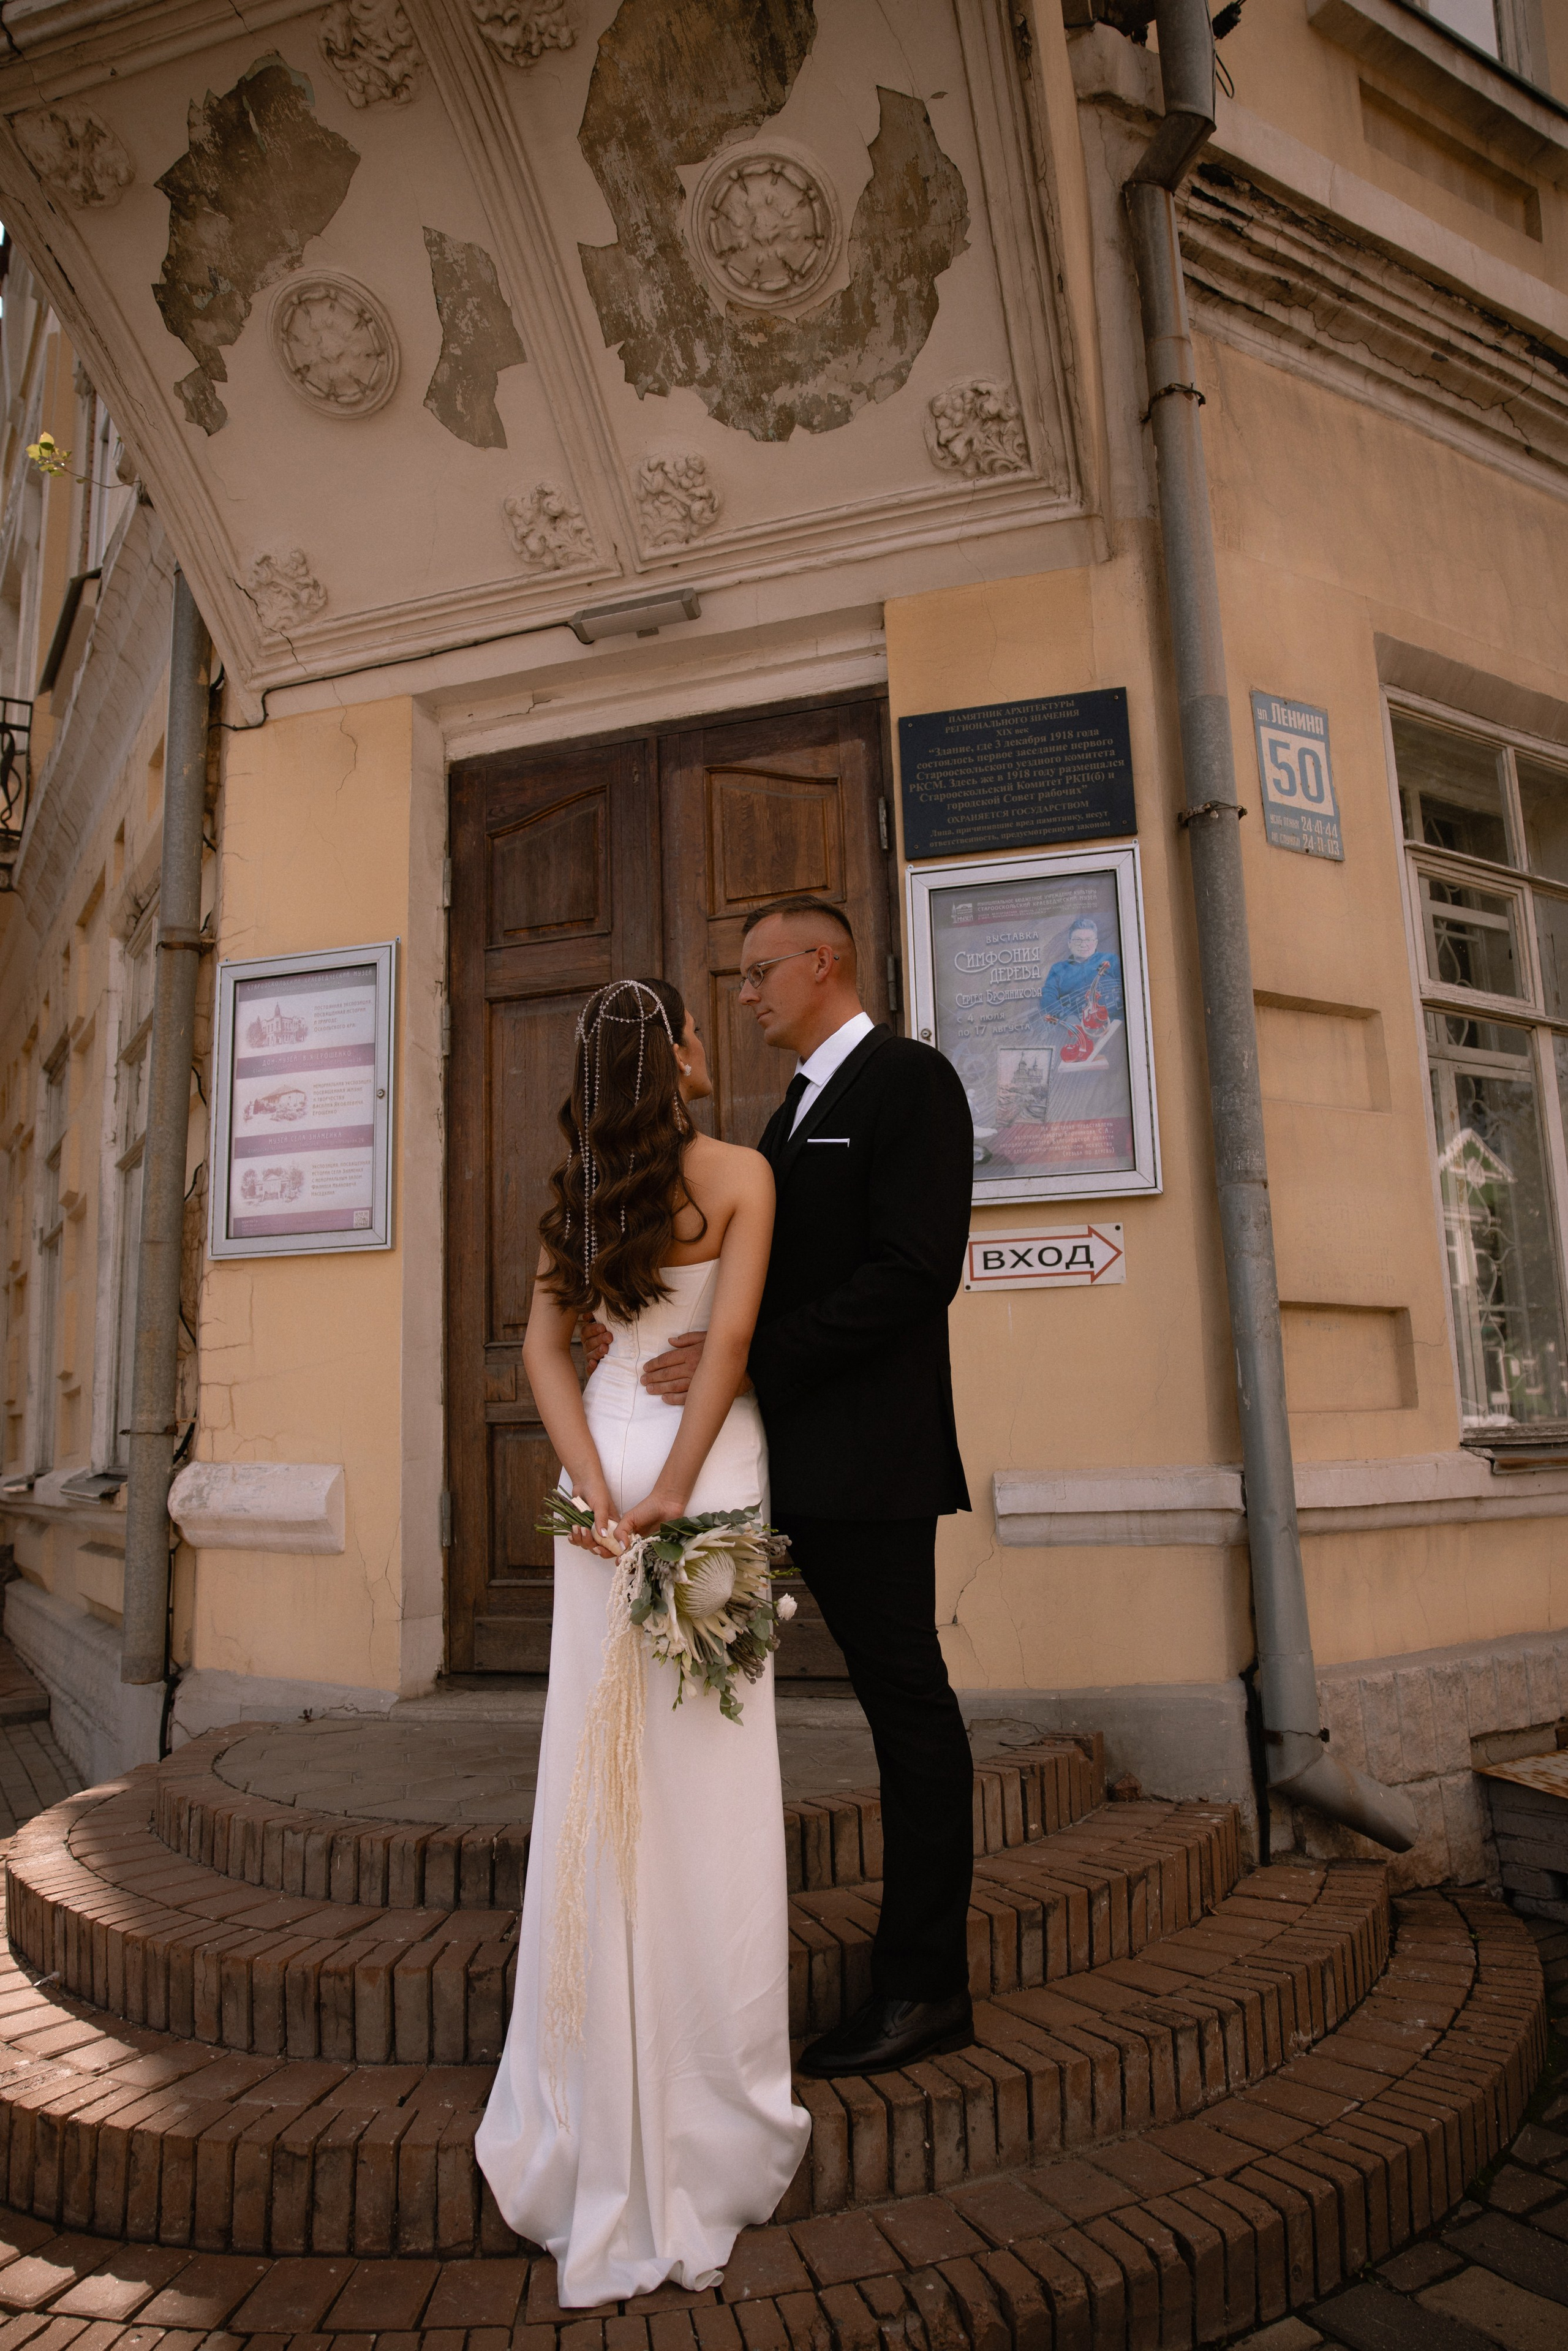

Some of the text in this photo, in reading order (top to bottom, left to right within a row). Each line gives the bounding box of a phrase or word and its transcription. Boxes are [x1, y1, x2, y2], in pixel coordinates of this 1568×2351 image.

[945, 709, 1079, 733] РЕГИОНАЛЬНОГО ЗНАЧЕНИЯ
[949, 700, 1074, 722] ПАМЯТНИК АРХИТЕКТУРЫ
[995, 739, 1000, 748] 3
[1003, 735, 1046, 748] декабря
[1050, 730, 1073, 741] 1918
[1077, 729, 1099, 738] года
[916, 738, 1113, 769] состоялось первое заседание первого
[916, 749, 1115, 780] Старооскольского уездного комитета
[1268, 738, 1325, 804] 50
[909, 780, 946, 792] РКСМ.
[949, 778, 977, 787] Здесь
[1007, 769, 1030, 780] 1918
[1033, 768, 1055, 777] году
[1058, 760, 1125, 775] размещался
[919, 782, 1013, 802] Старооскольский
[1016, 779, 1062, 790] Комитет
[1065, 771, 1105, 784] РКП(б)
[947, 795, 1000, 811] городской
[1003, 793, 1035, 802] Совет
[947, 800, 1088, 824] ОХРАНЯЕТСЯ ГОСУДАРСТВОМ
[929, 821, 1110, 847] ответственность, предусмотренную законом
[956, 822, 1013, 835] причинившие
[1036, 814, 1083, 825] памятнику,
[1301, 816, 1338, 839] 24-41-44
[1302, 834, 1340, 855] 24-11-03
[977, 898, 1013, 907] МУНИЦИПАЛЬНОЕ
[978, 901, 1030, 912] СТАРООСКОЛЬСКИЙ
[1033, 896, 1076, 906] КРАЕВЕДЧЕСКИЙ
[986, 930, 1038, 943] ВЫСТАВКА
[247, 978, 300, 991] СТАРООСКОЛЬСКИЙ
[304, 972, 349, 983] КРАЕВЕДЧЕСКИЙ
[989, 964, 1041, 984] ДЕРЕВА
[967, 1013, 973, 1021] 4
[974, 1024, 986, 1035] 17
[262, 1055, 297, 1066] ДОМ-МУЗЕЙ
[268, 1136, 287, 1144] МУЗЕЙ
[309, 1131, 341, 1140] ЗНАМЕНКА
[983, 1245, 1094, 1270] ВХОД
